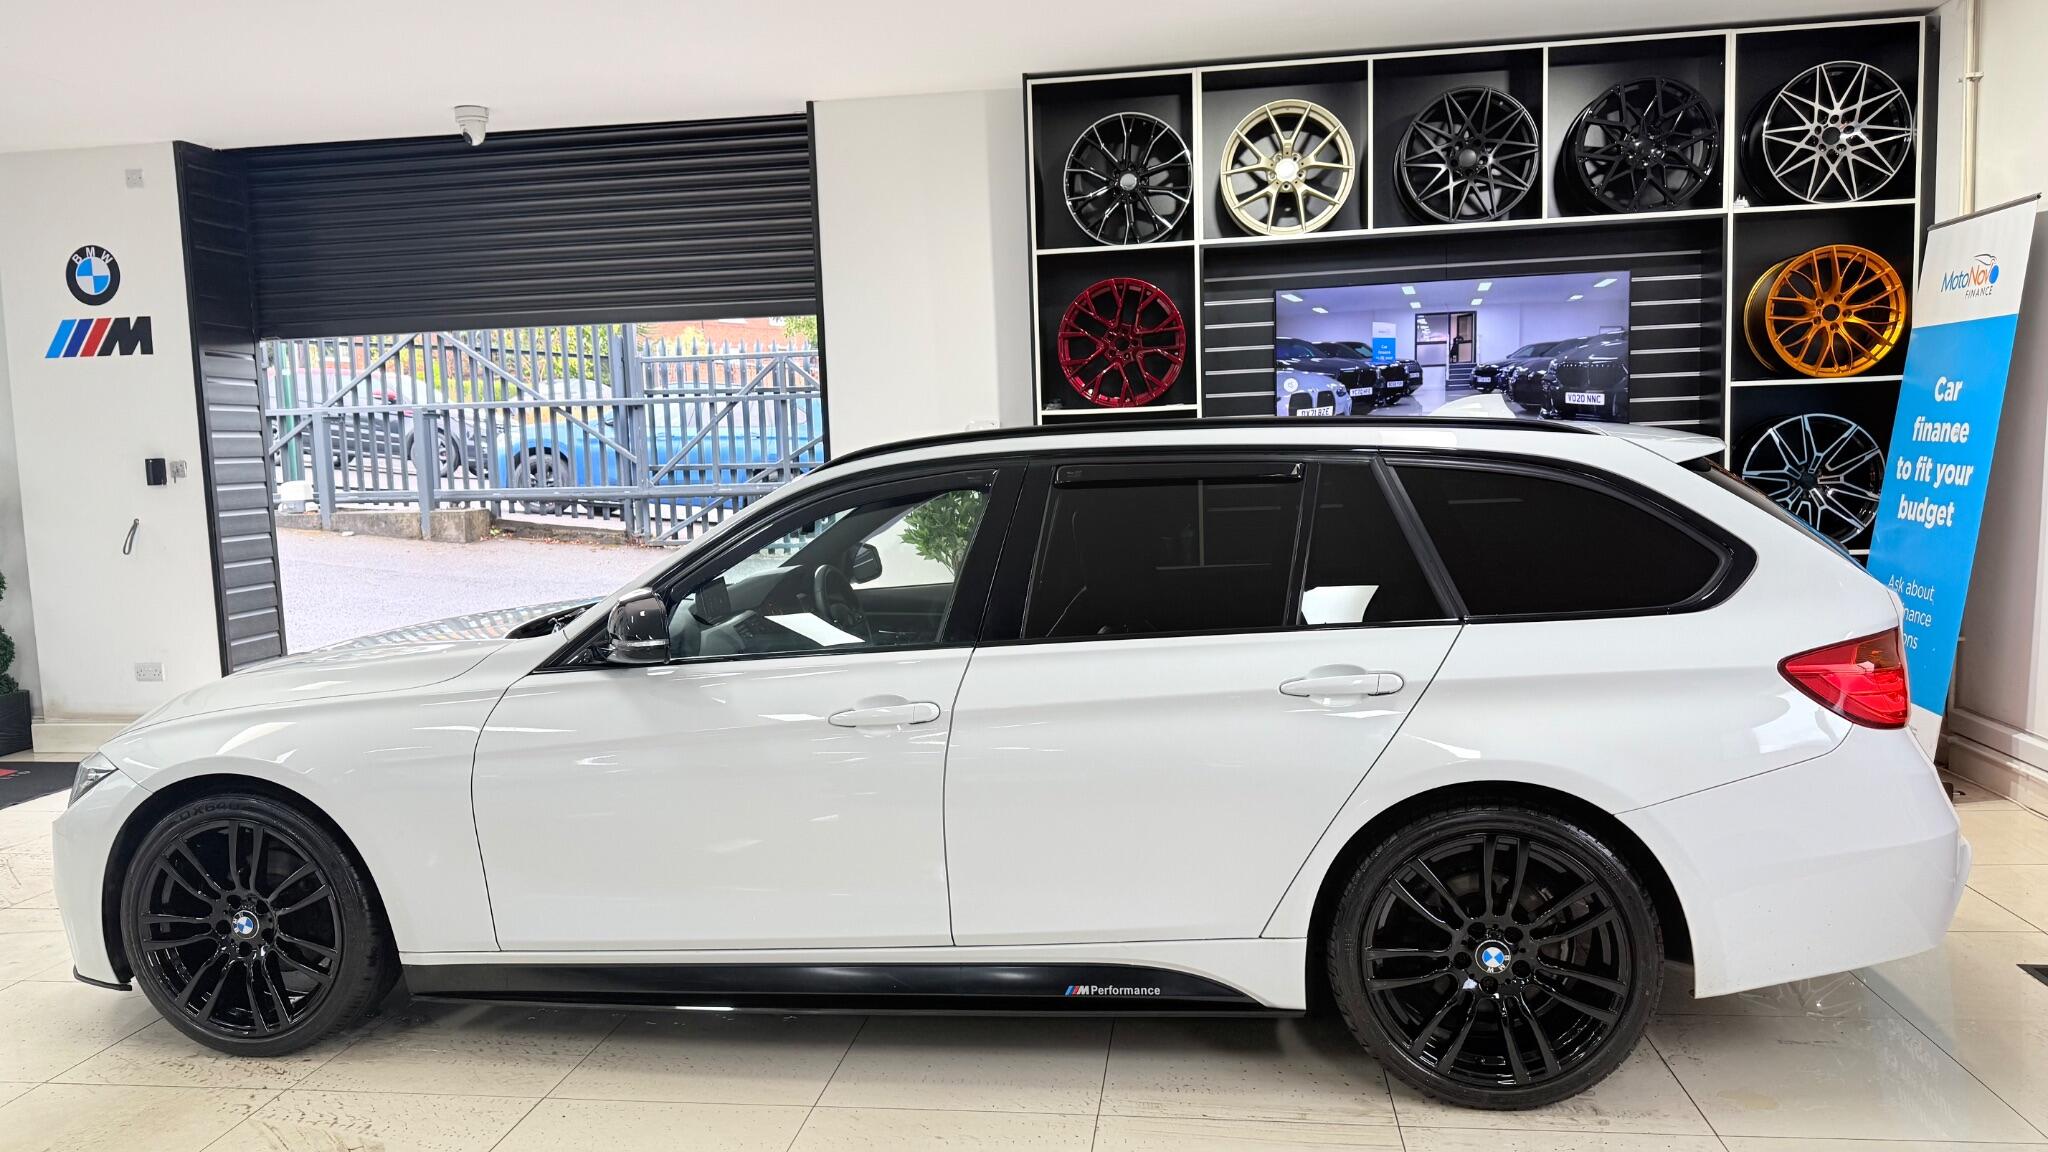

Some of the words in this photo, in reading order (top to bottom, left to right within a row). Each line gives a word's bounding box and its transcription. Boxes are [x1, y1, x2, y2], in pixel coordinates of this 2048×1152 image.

[72, 247, 113, 264] BMW
[1965, 286, 1993, 299] FINANCE
[1934, 376, 1963, 402] Car
[1912, 416, 1970, 443] finance
[1896, 456, 1912, 480] to
[1914, 456, 1933, 482] fit
[1933, 463, 1974, 489] your
[1897, 494, 1955, 529] budget
[1888, 574, 1904, 593] Ask
[1905, 580, 1935, 602] about
[1091, 985, 1161, 995] Performance
